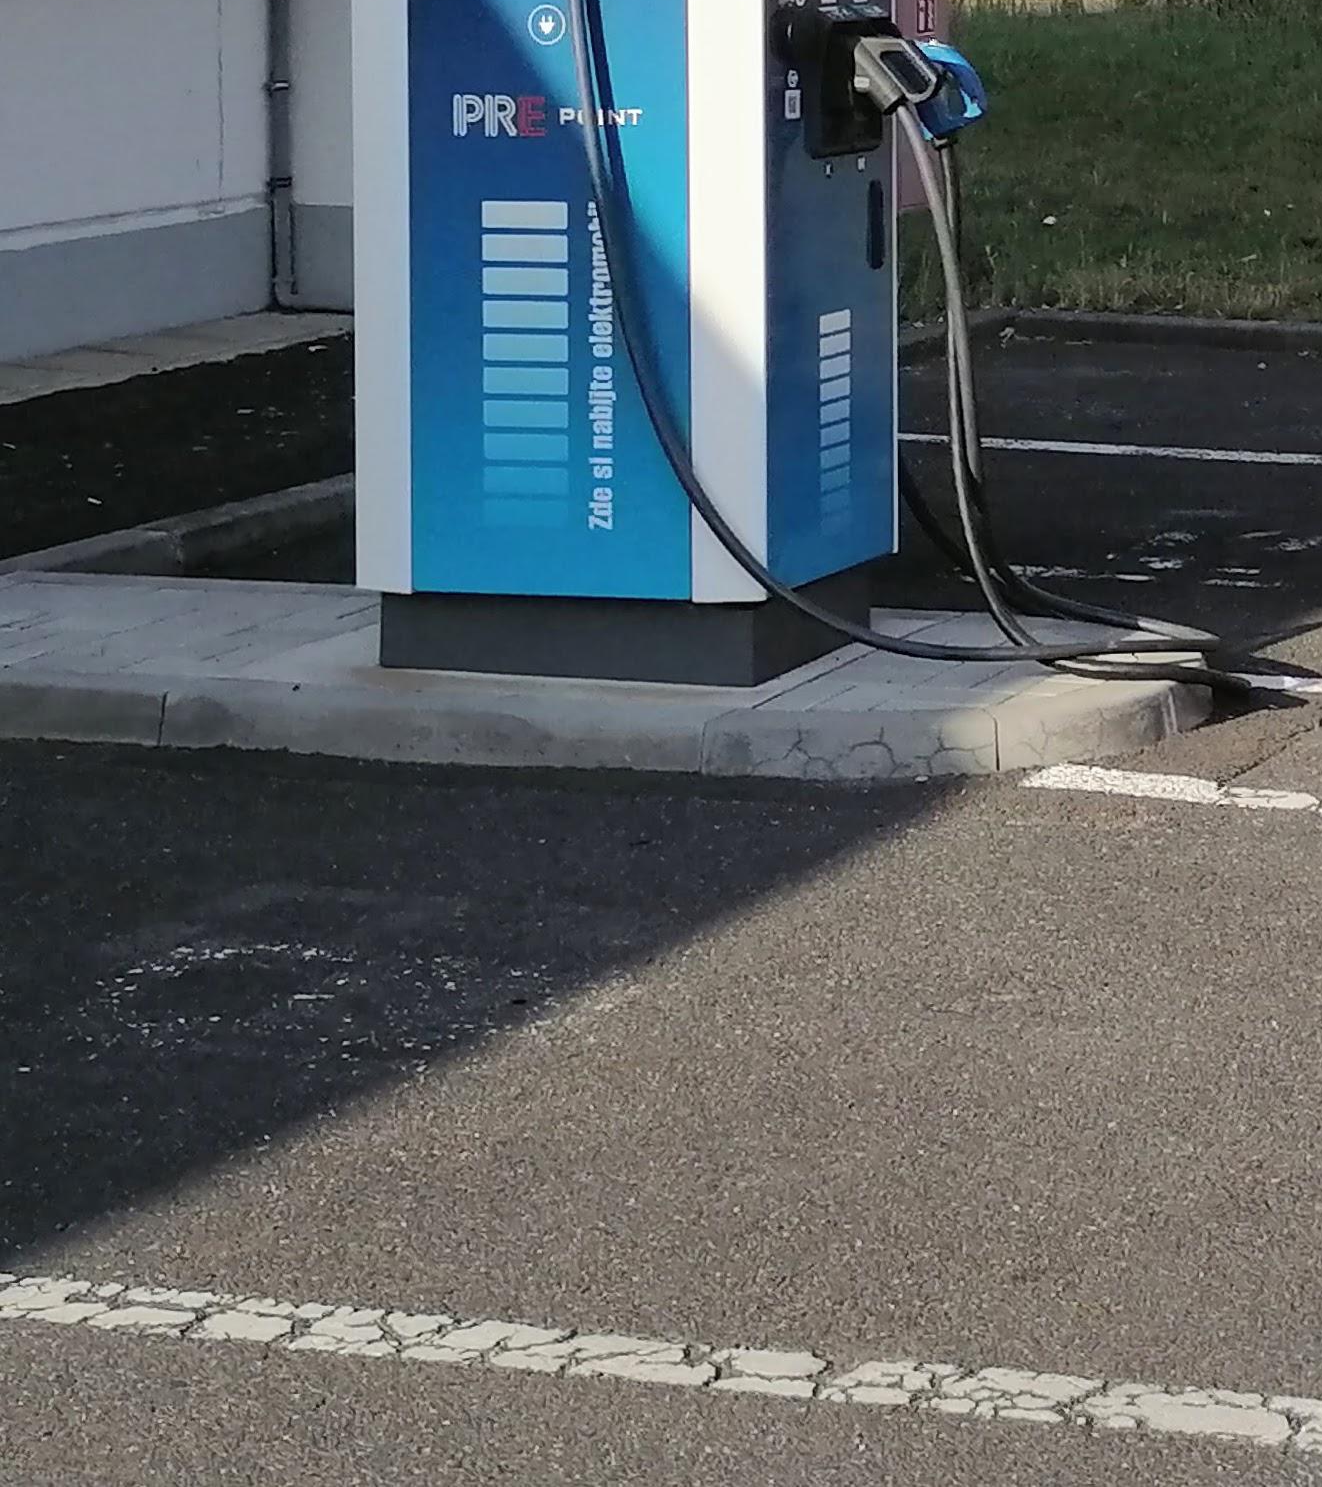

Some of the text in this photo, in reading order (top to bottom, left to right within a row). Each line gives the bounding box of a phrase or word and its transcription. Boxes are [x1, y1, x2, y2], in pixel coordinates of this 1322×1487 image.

[453, 94, 546, 138] PRE
[588, 366, 617, 450] nabijte
[588, 457, 614, 480] si
[588, 487, 614, 531] Zde
